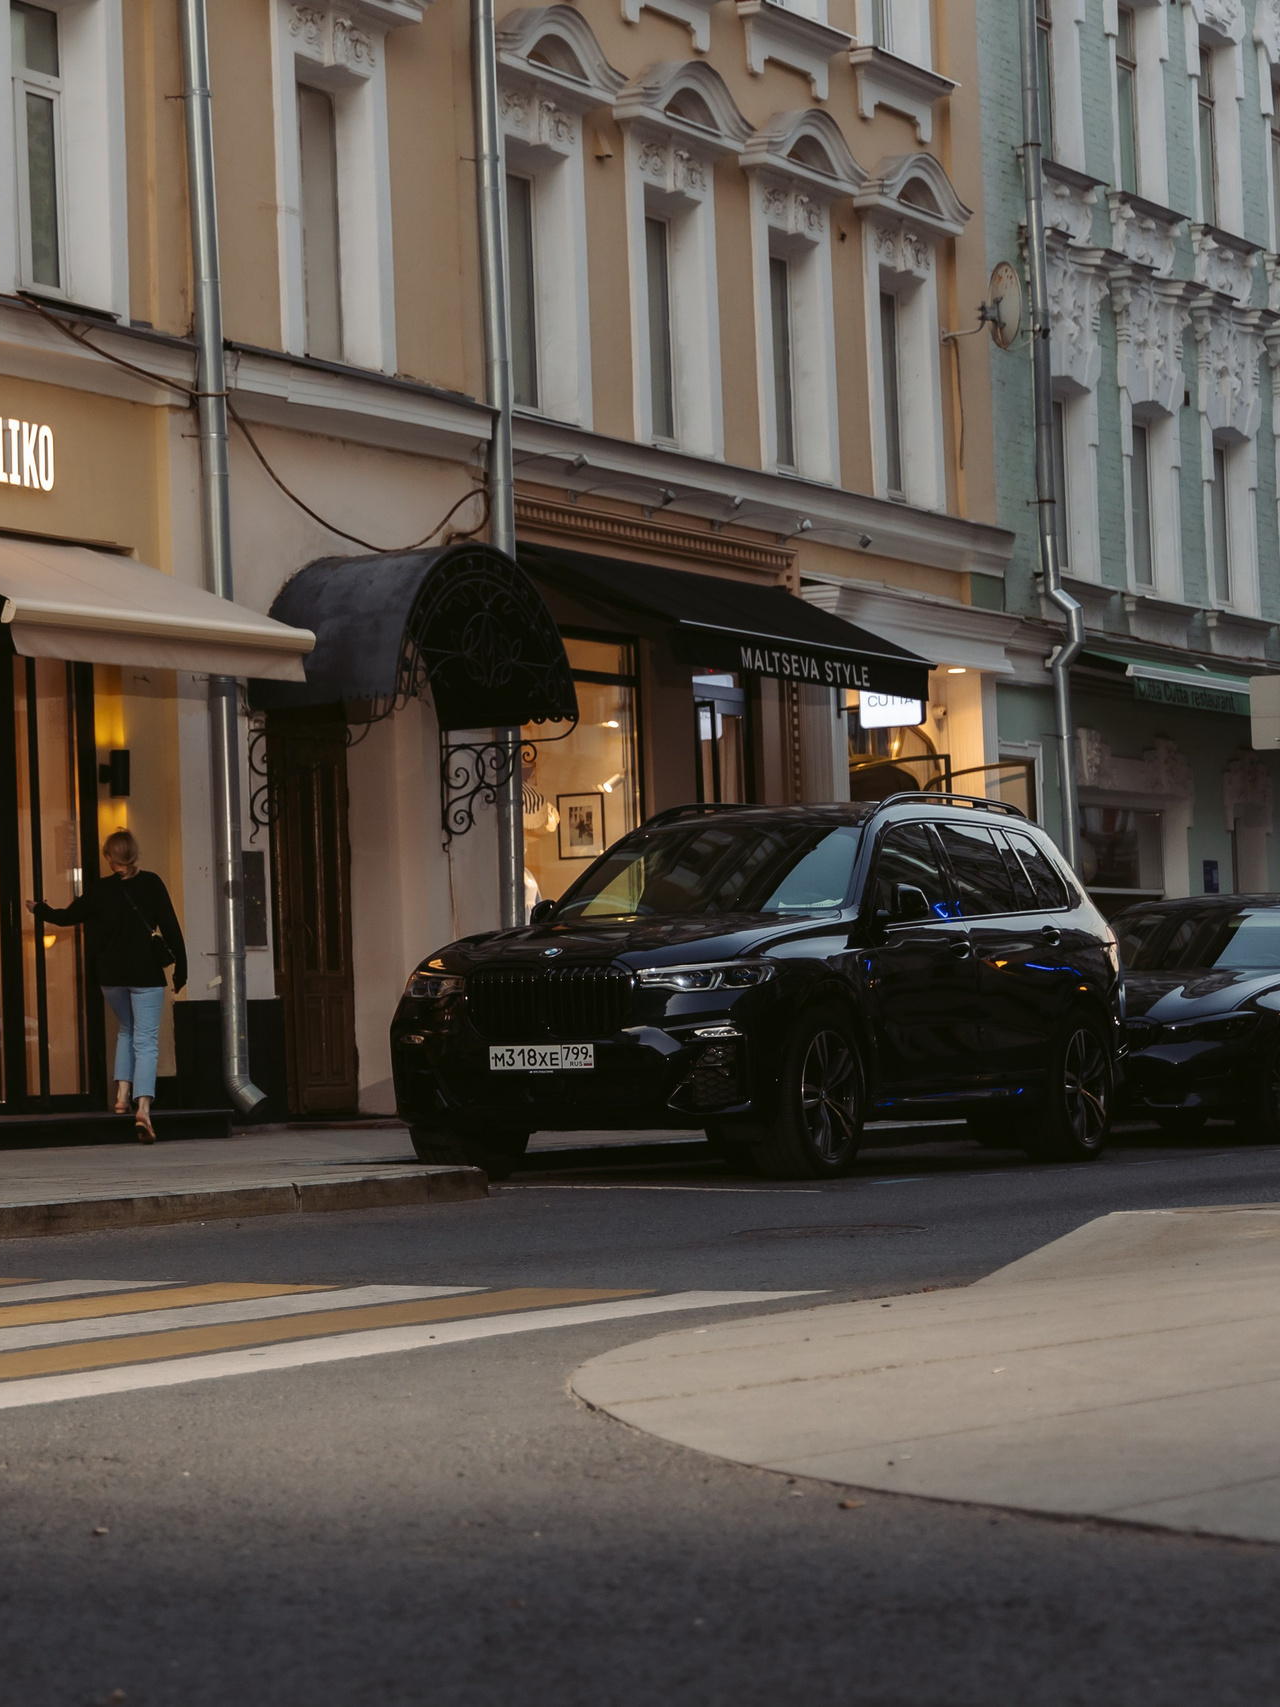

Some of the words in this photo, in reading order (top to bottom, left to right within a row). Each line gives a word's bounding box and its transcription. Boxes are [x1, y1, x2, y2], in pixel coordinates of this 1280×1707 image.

[741, 646, 820, 680] MALTSEVA
[825, 660, 871, 687] STYLE
[1164, 682, 1189, 704] Cutta
[1191, 690, 1235, 711] restaurant
[494, 1048, 559, 1067] М318ХЕ
[563, 1046, 589, 1060] 799
